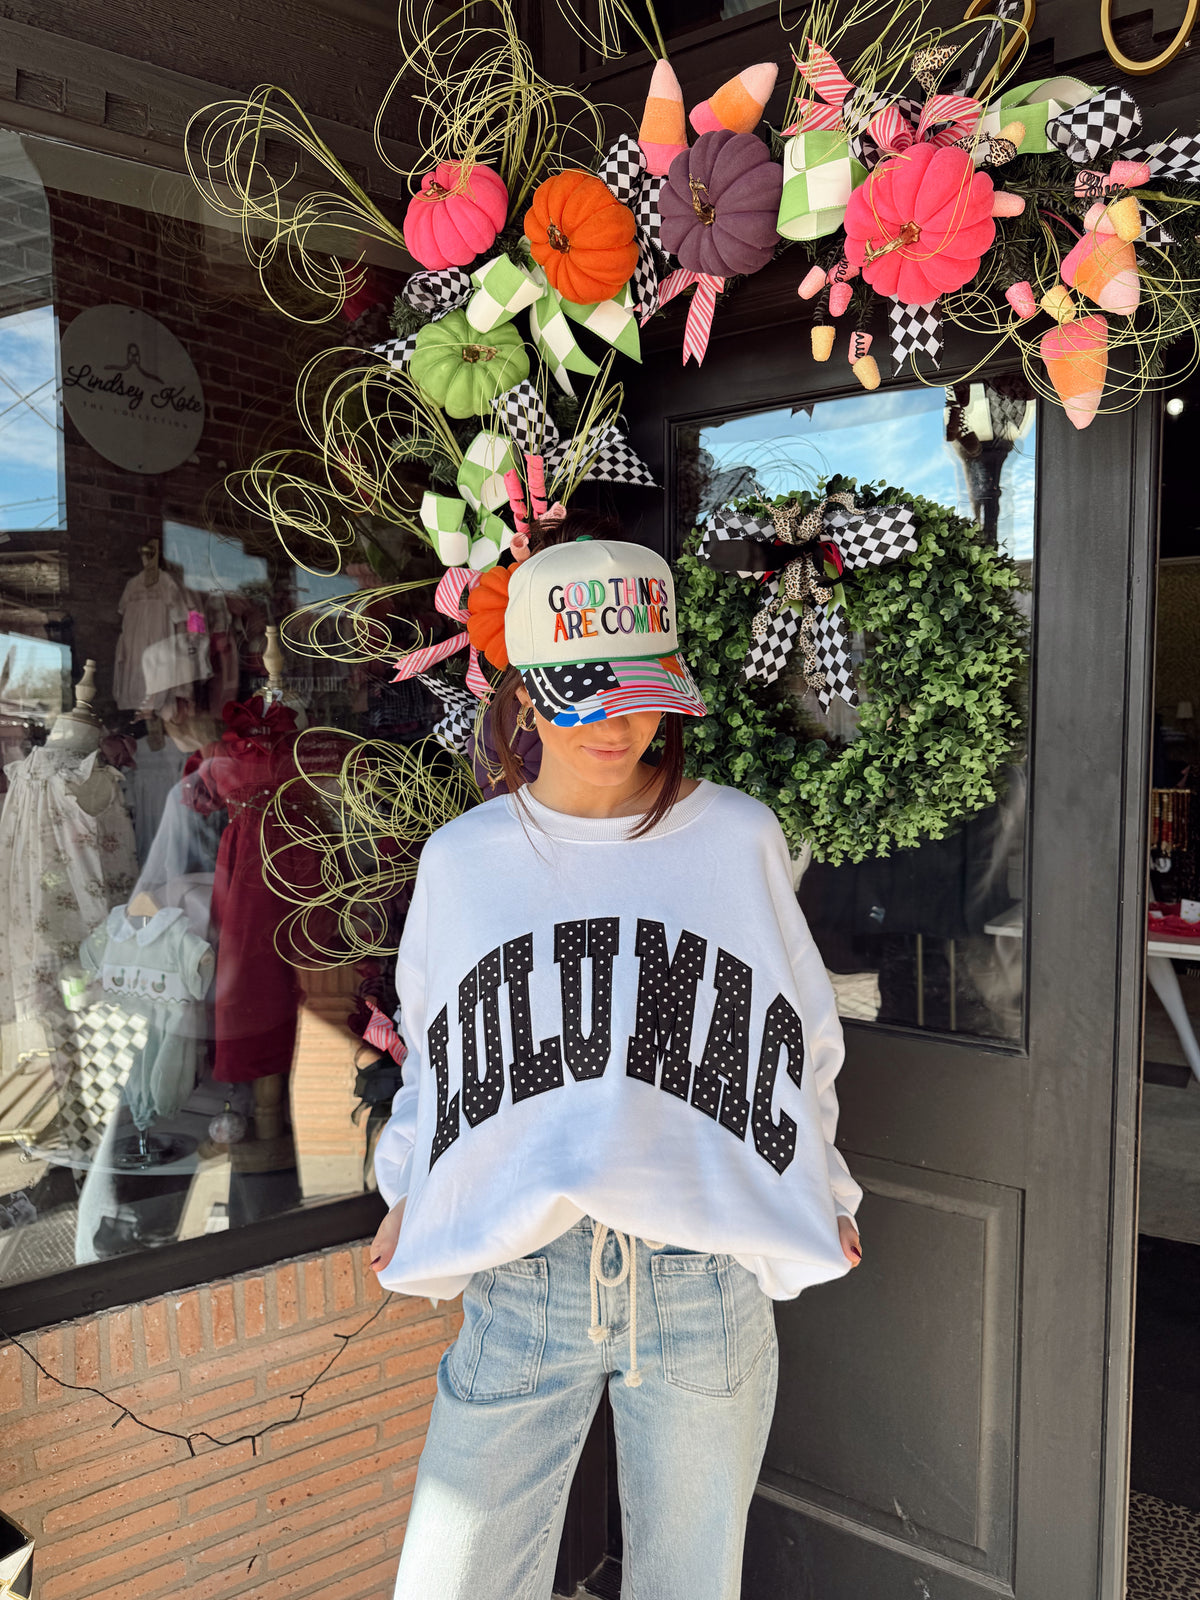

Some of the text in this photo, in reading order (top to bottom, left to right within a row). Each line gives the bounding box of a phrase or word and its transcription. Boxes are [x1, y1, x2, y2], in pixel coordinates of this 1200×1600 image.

[63, 365, 202, 413] Lindsey Kate
[83, 401, 189, 430] THE COLLECTION
[548, 577, 668, 613] GOOD THINGS
[554, 605, 670, 643] ARE COMING
